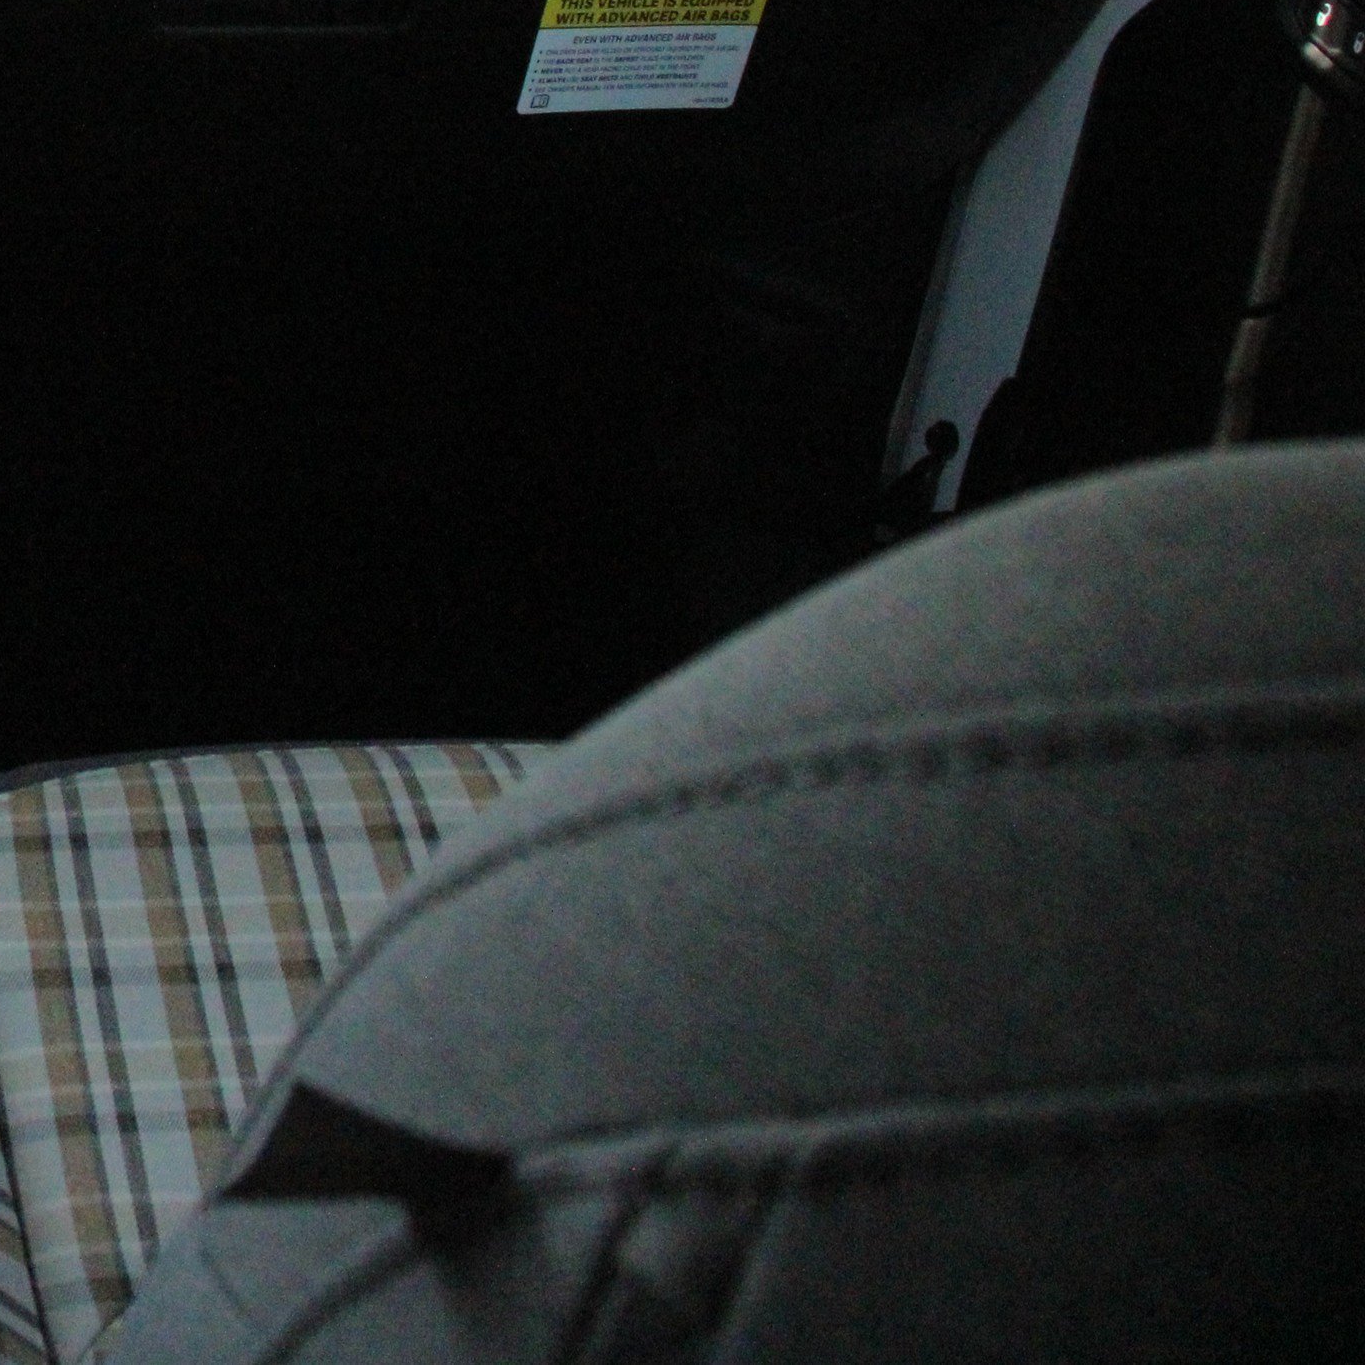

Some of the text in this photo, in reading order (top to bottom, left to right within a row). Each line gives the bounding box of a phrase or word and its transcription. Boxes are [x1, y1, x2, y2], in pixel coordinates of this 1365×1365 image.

[555, 10, 750, 25] WITH ADVANCED AIR BAGS
[573, 35, 597, 44] EVEN
[599, 34, 623, 43] WITH
[624, 33, 673, 43] ADVANCED
